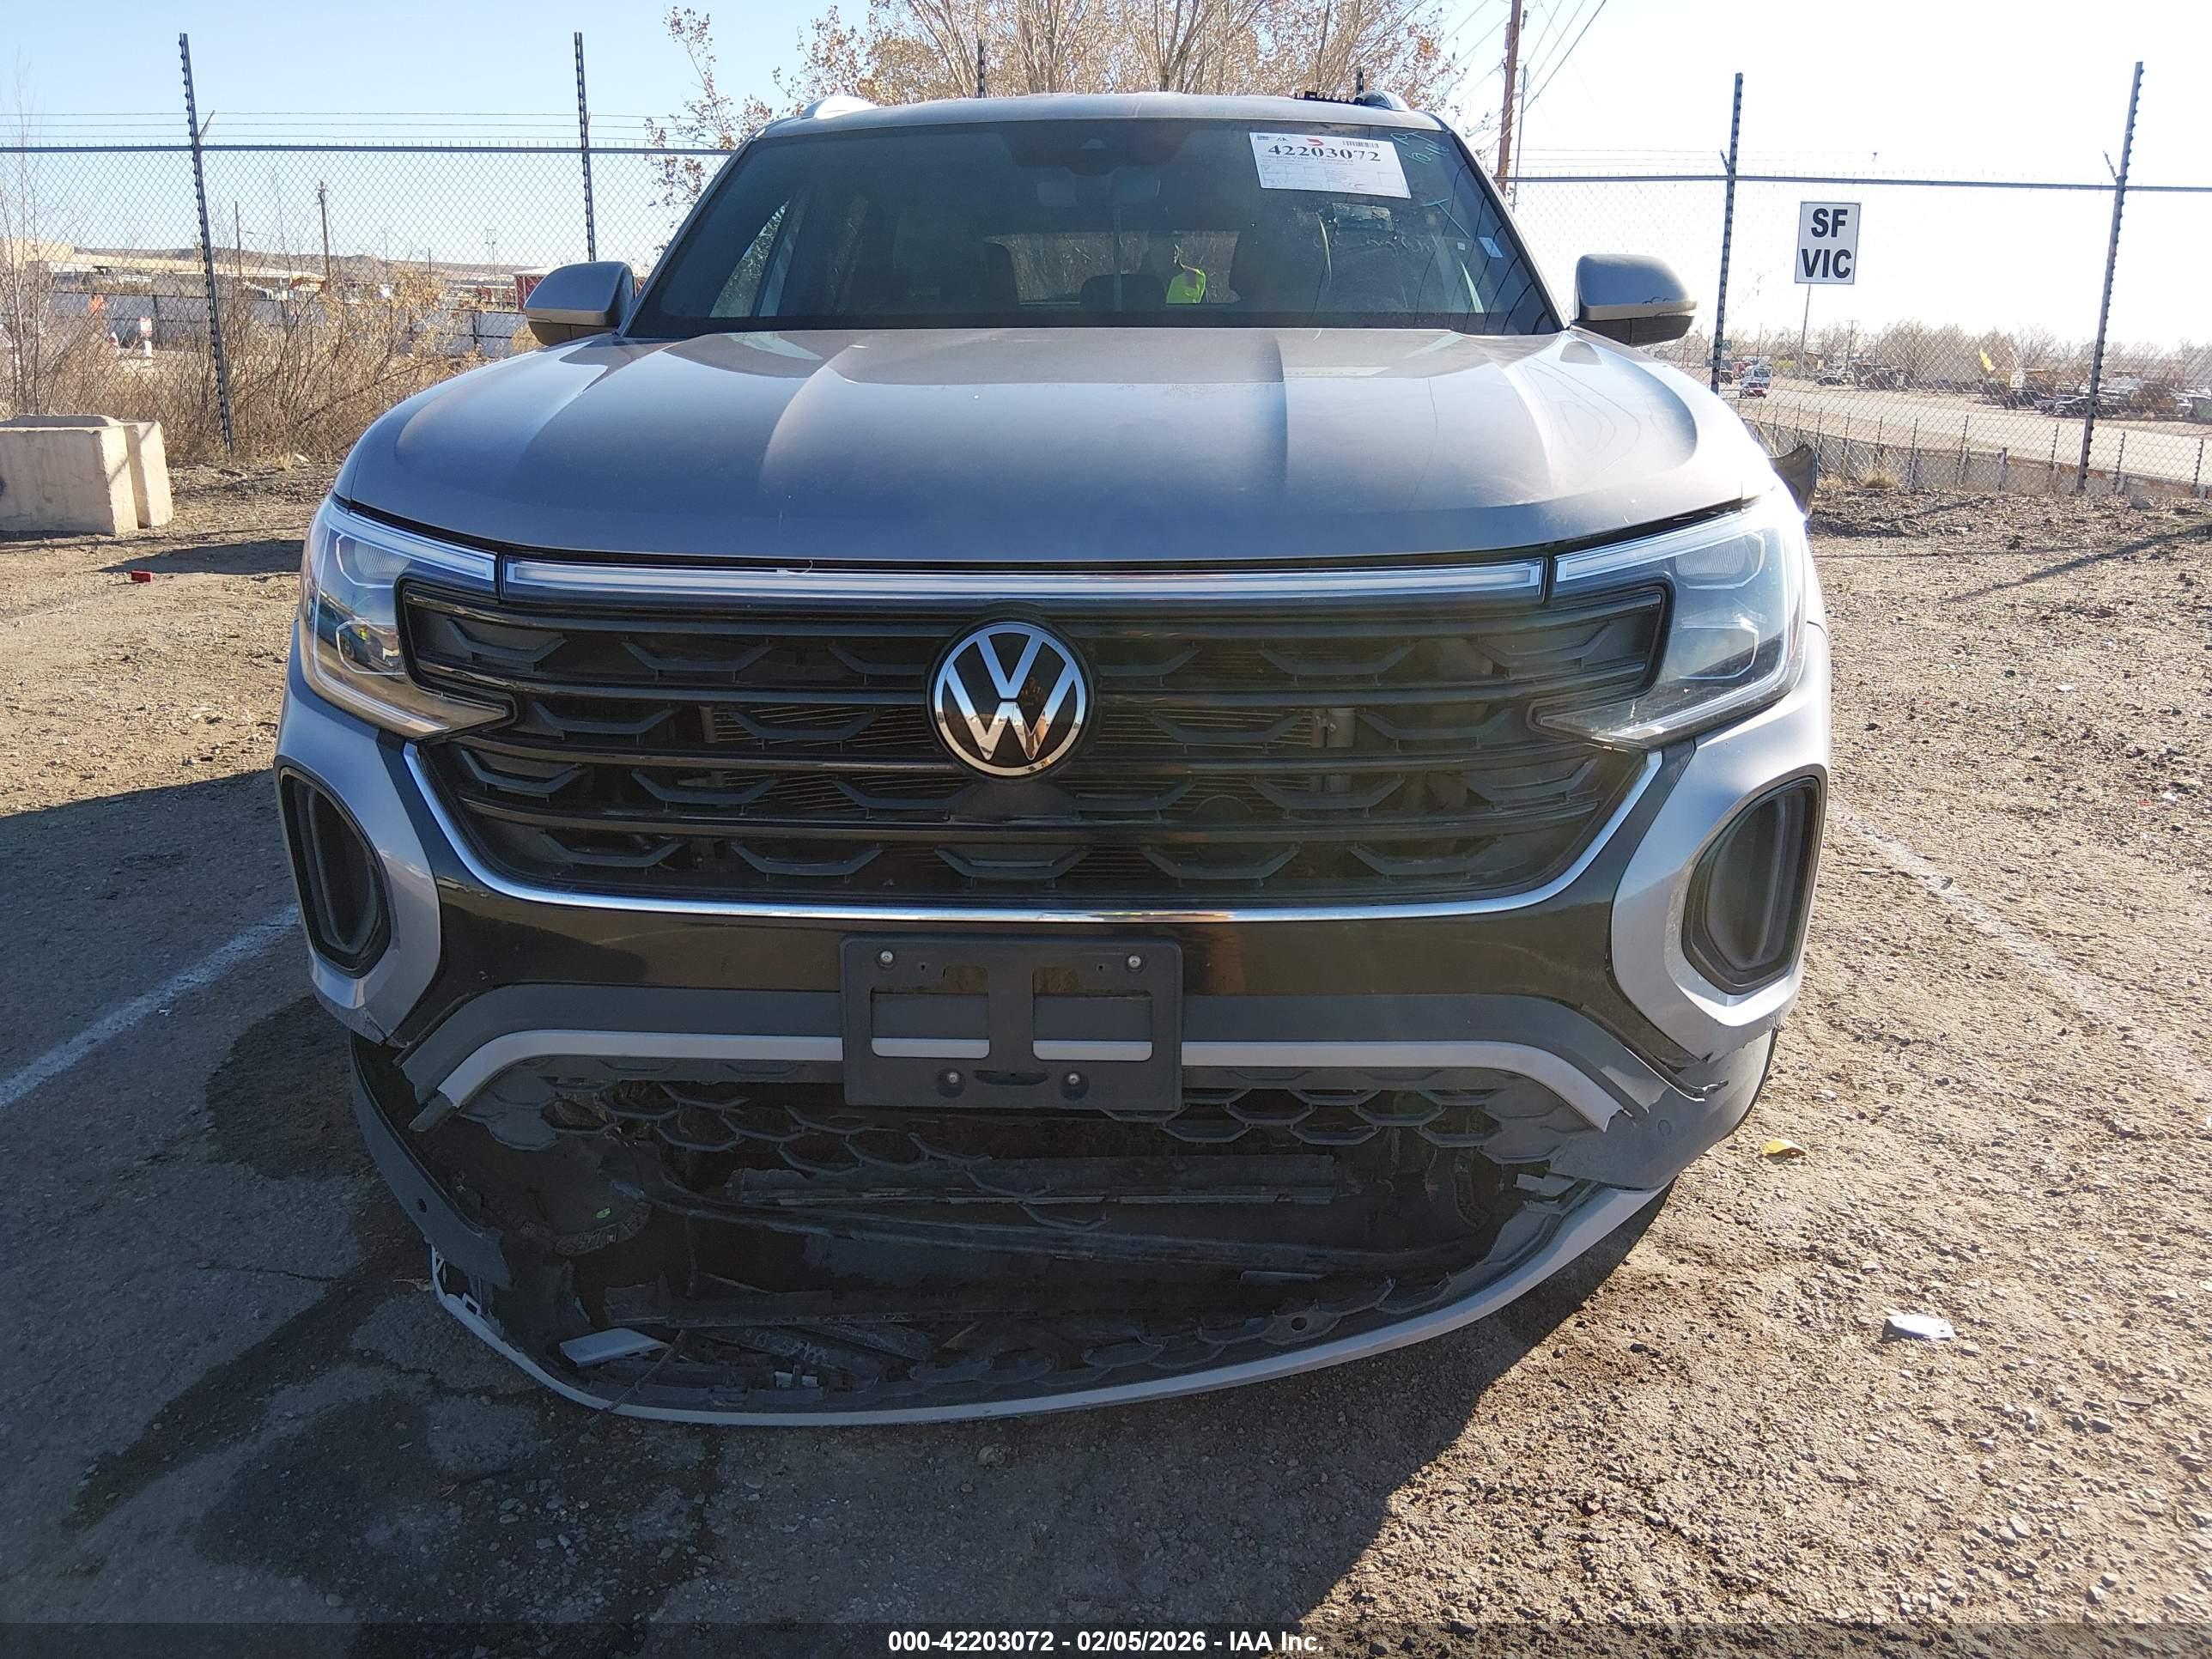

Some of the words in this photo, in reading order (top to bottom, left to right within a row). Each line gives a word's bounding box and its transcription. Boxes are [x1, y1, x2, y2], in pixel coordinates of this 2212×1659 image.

[1268, 144, 1382, 161] 42203072
[1811, 208, 1848, 238] SF
[1801, 248, 1852, 279] VIC
